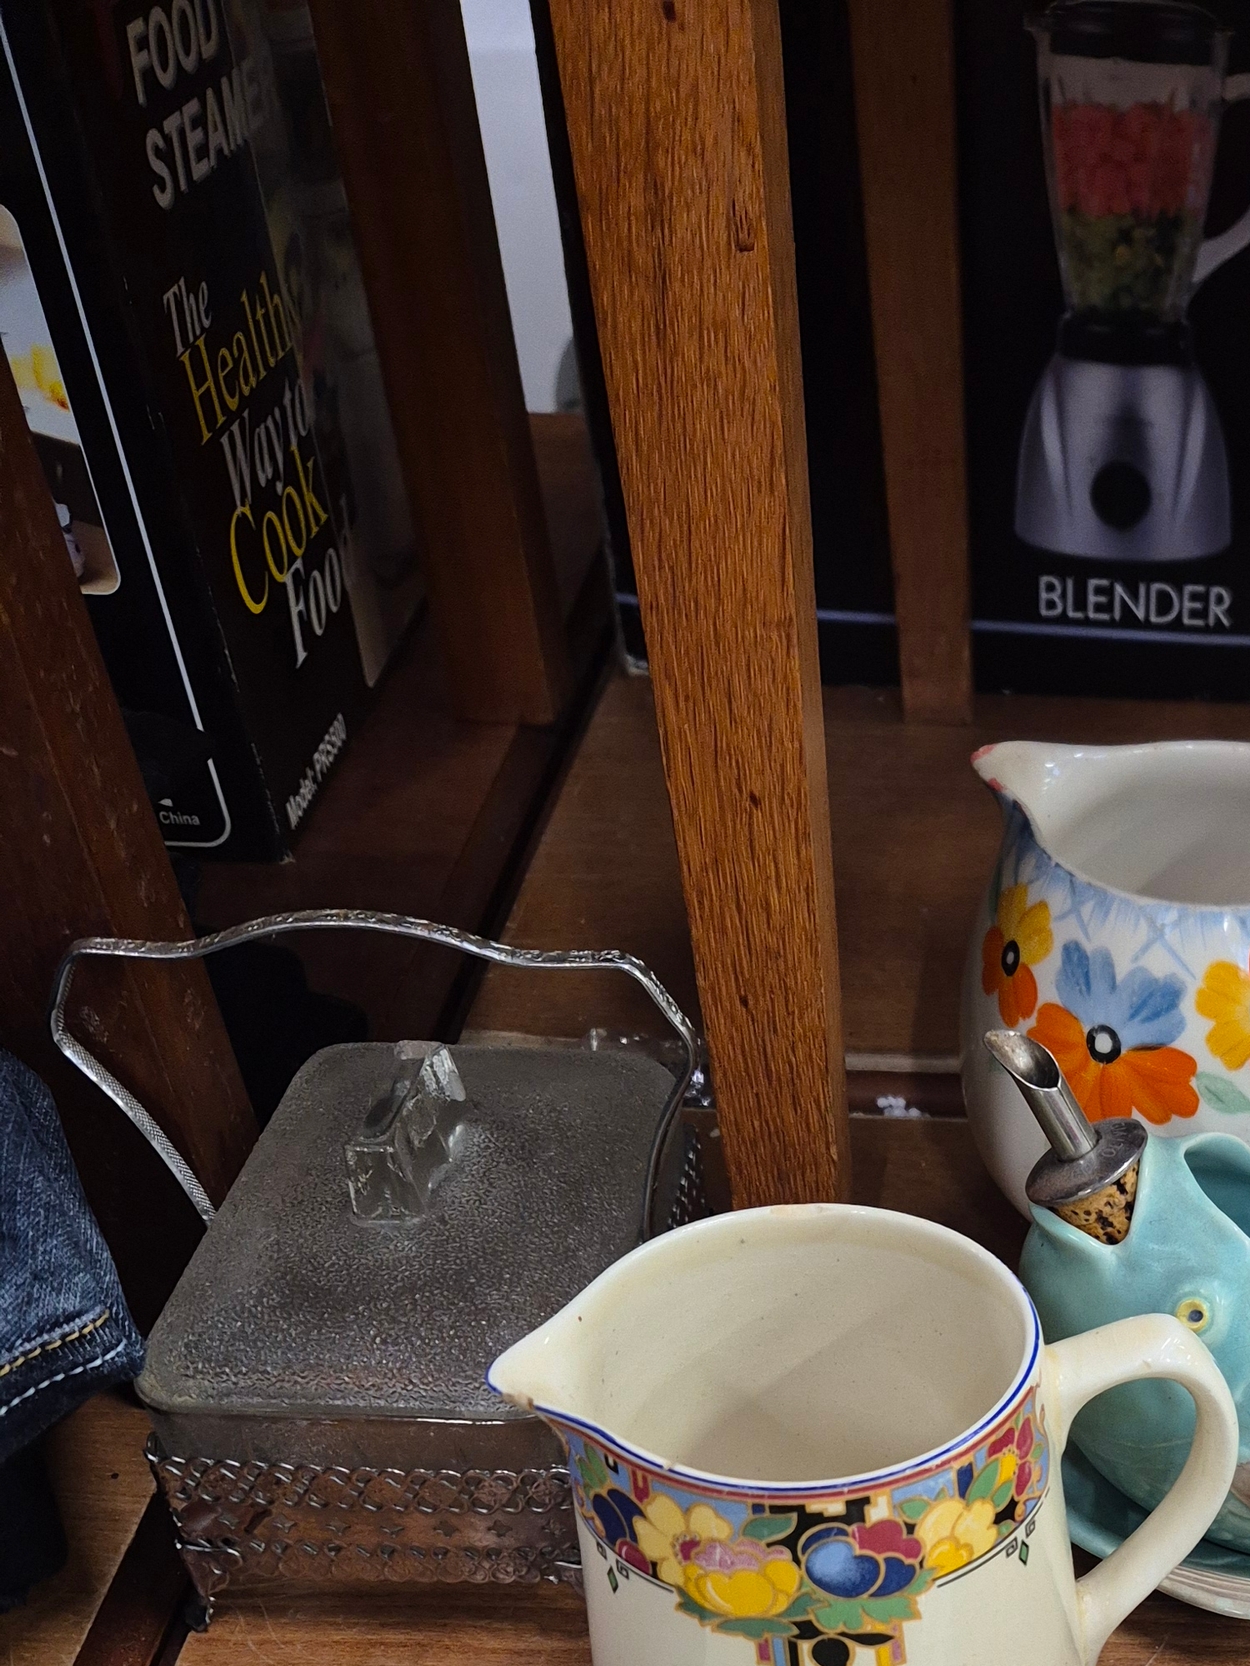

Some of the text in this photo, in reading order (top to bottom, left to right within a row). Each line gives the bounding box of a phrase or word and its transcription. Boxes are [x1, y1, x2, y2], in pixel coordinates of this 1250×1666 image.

[126, 0, 219, 108] FOOD
[162, 275, 212, 359] The
[219, 376, 309, 517] Way to
[229, 445, 329, 615] Cook
[284, 493, 353, 670] Food
[1038, 575, 1232, 628] BLENDER
[158, 810, 201, 826] China
